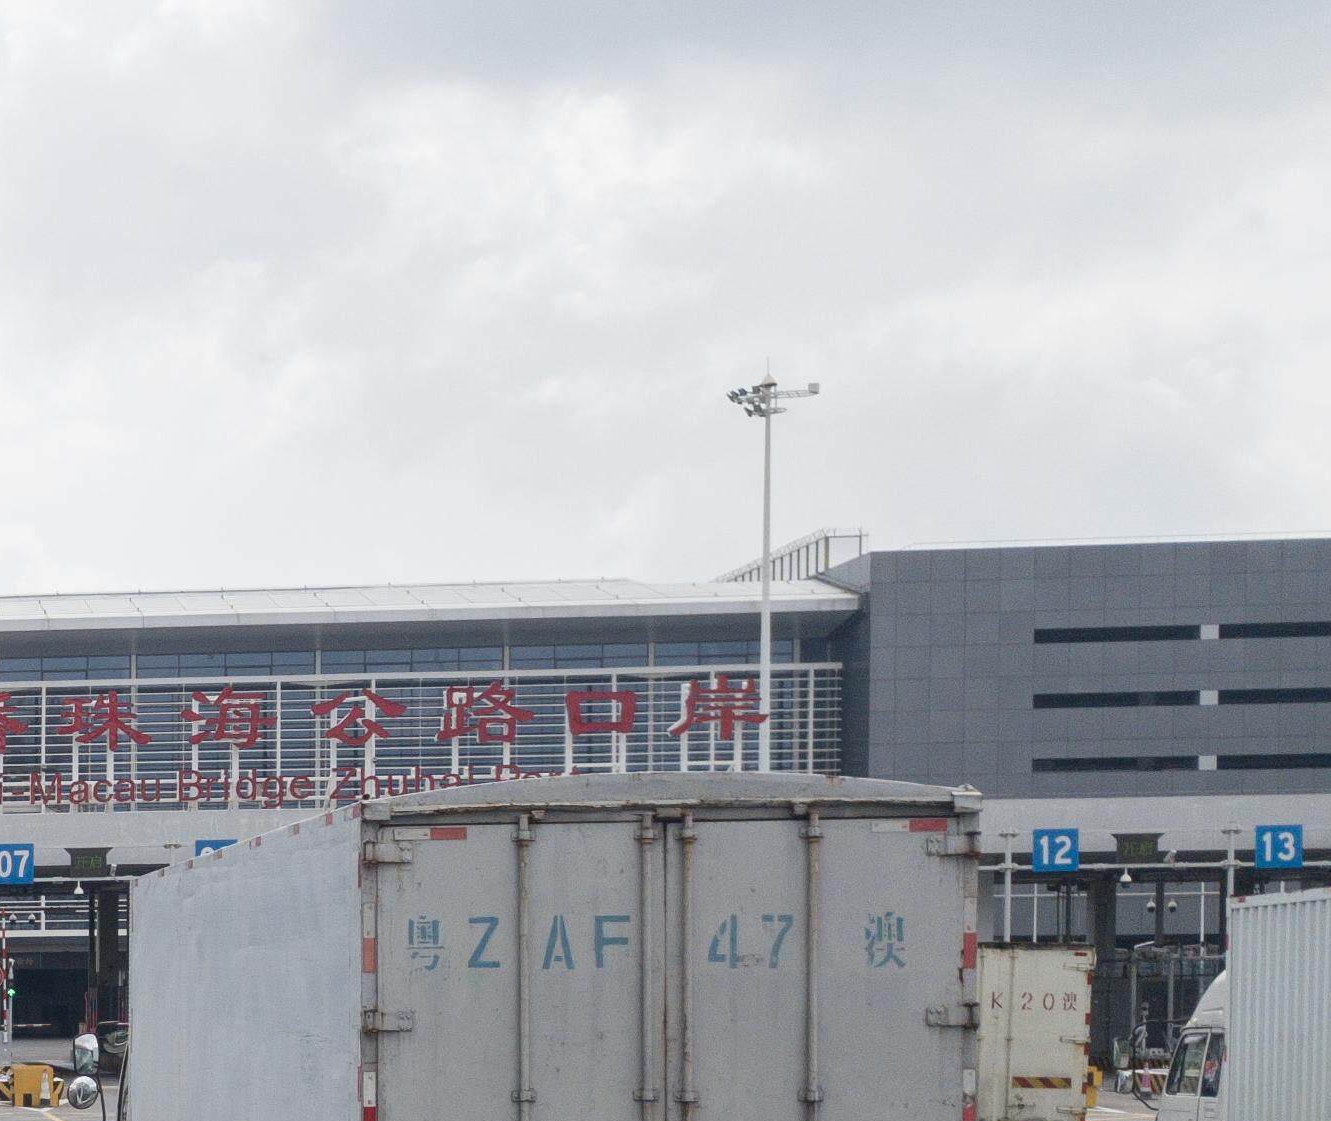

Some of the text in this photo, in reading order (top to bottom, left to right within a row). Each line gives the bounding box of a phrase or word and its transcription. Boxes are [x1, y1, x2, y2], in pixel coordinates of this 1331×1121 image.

[178, 768, 314, 810] Bridge
[1039, 836, 1072, 865] 12
[1262, 832, 1296, 862] 13
